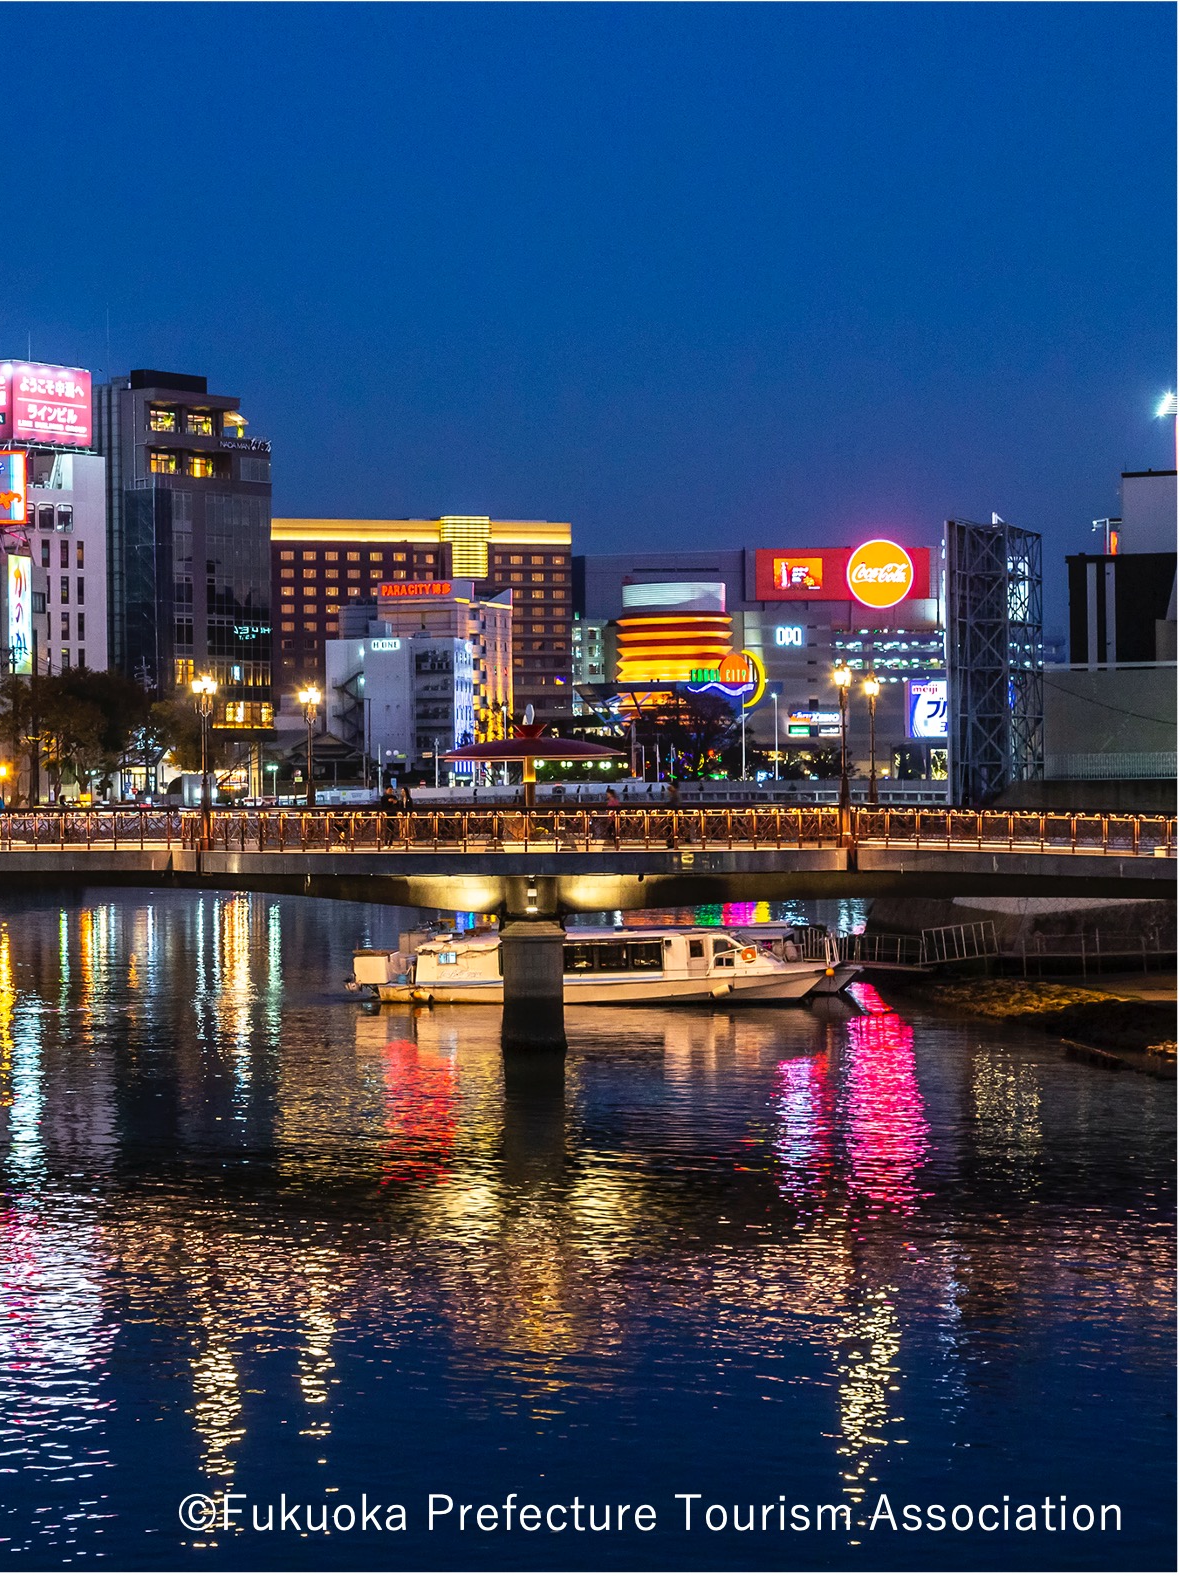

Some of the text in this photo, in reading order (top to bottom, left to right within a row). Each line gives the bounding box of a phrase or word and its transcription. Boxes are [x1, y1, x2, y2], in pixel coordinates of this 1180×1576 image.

[26, 403, 78, 425] ラインビル
[851, 562, 909, 584] Coca-Cola
[725, 668, 747, 683] CITY
[913, 683, 939, 695] meiji
